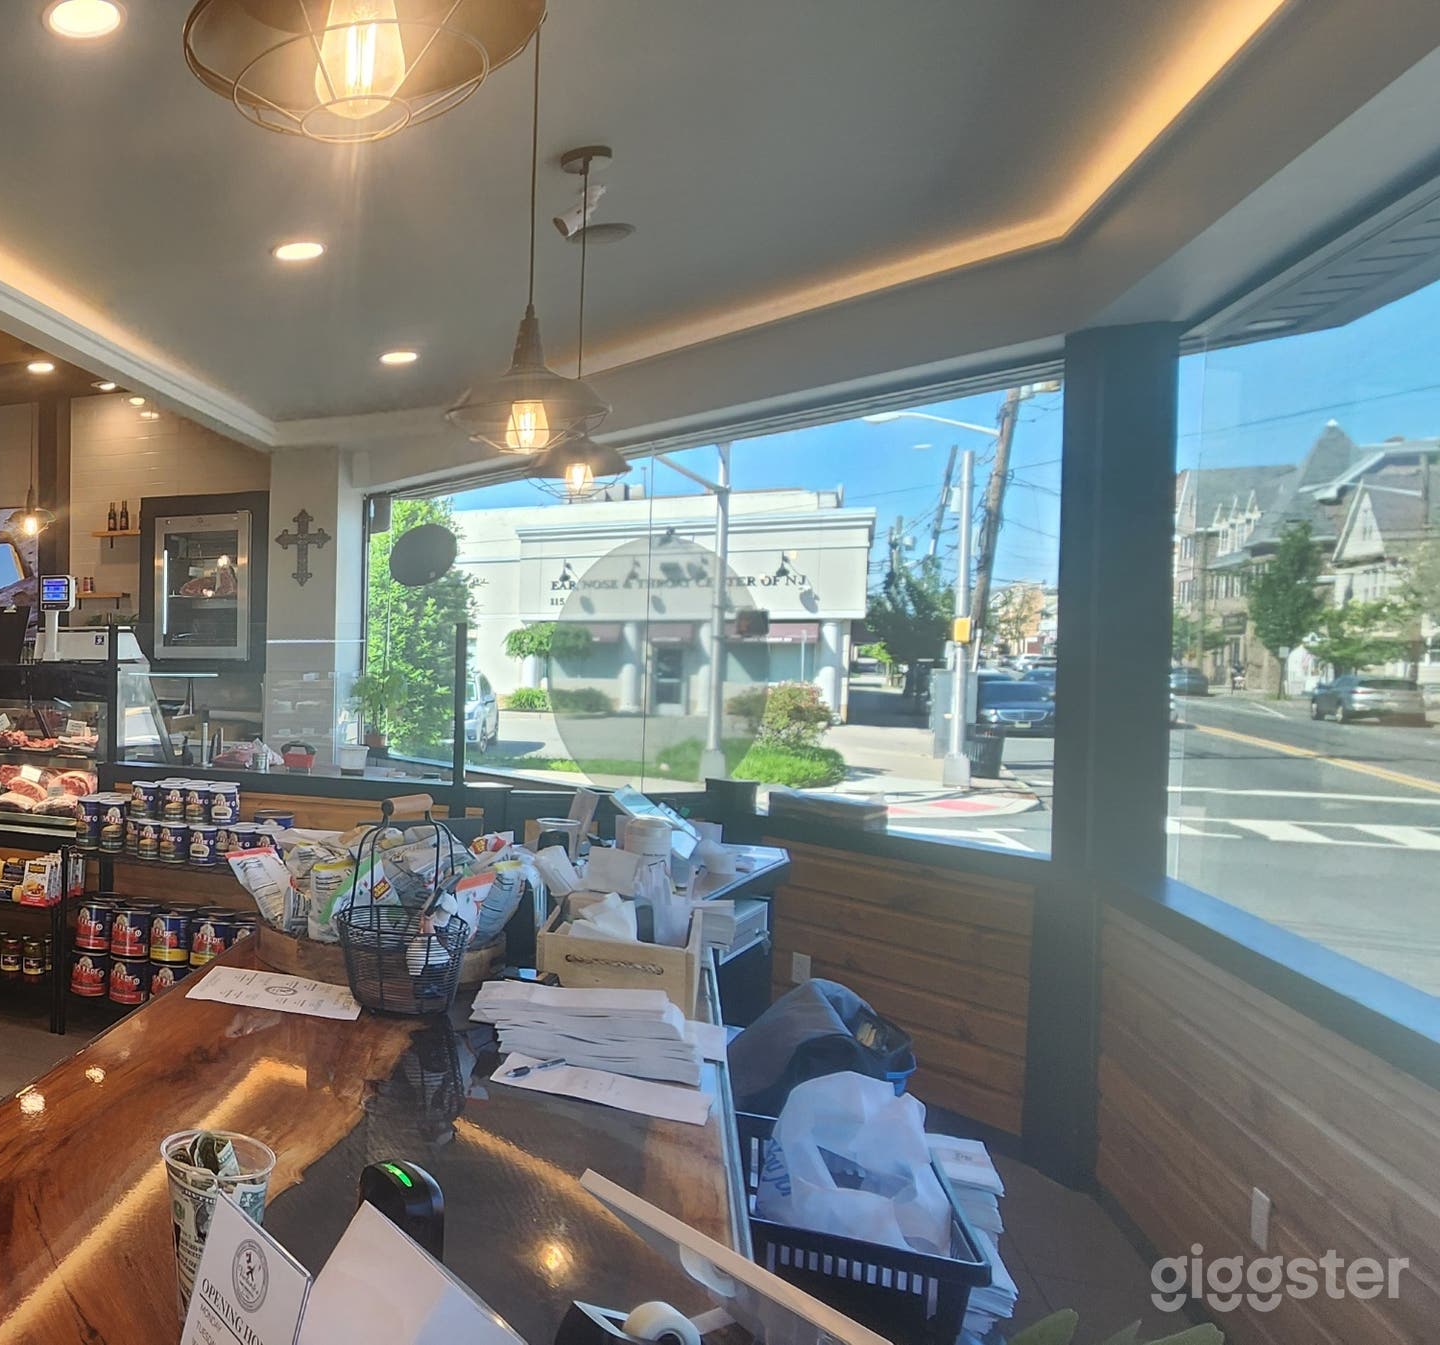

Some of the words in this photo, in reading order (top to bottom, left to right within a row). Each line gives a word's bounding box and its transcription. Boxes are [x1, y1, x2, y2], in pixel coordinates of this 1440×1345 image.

[582, 579, 618, 590] NOSE
[695, 575, 757, 589] CETER
[760, 575, 781, 587] OF
[785, 574, 807, 587] NJ
[200, 1303, 222, 1331] MONDAY
[202, 1278, 244, 1333] OPENING
